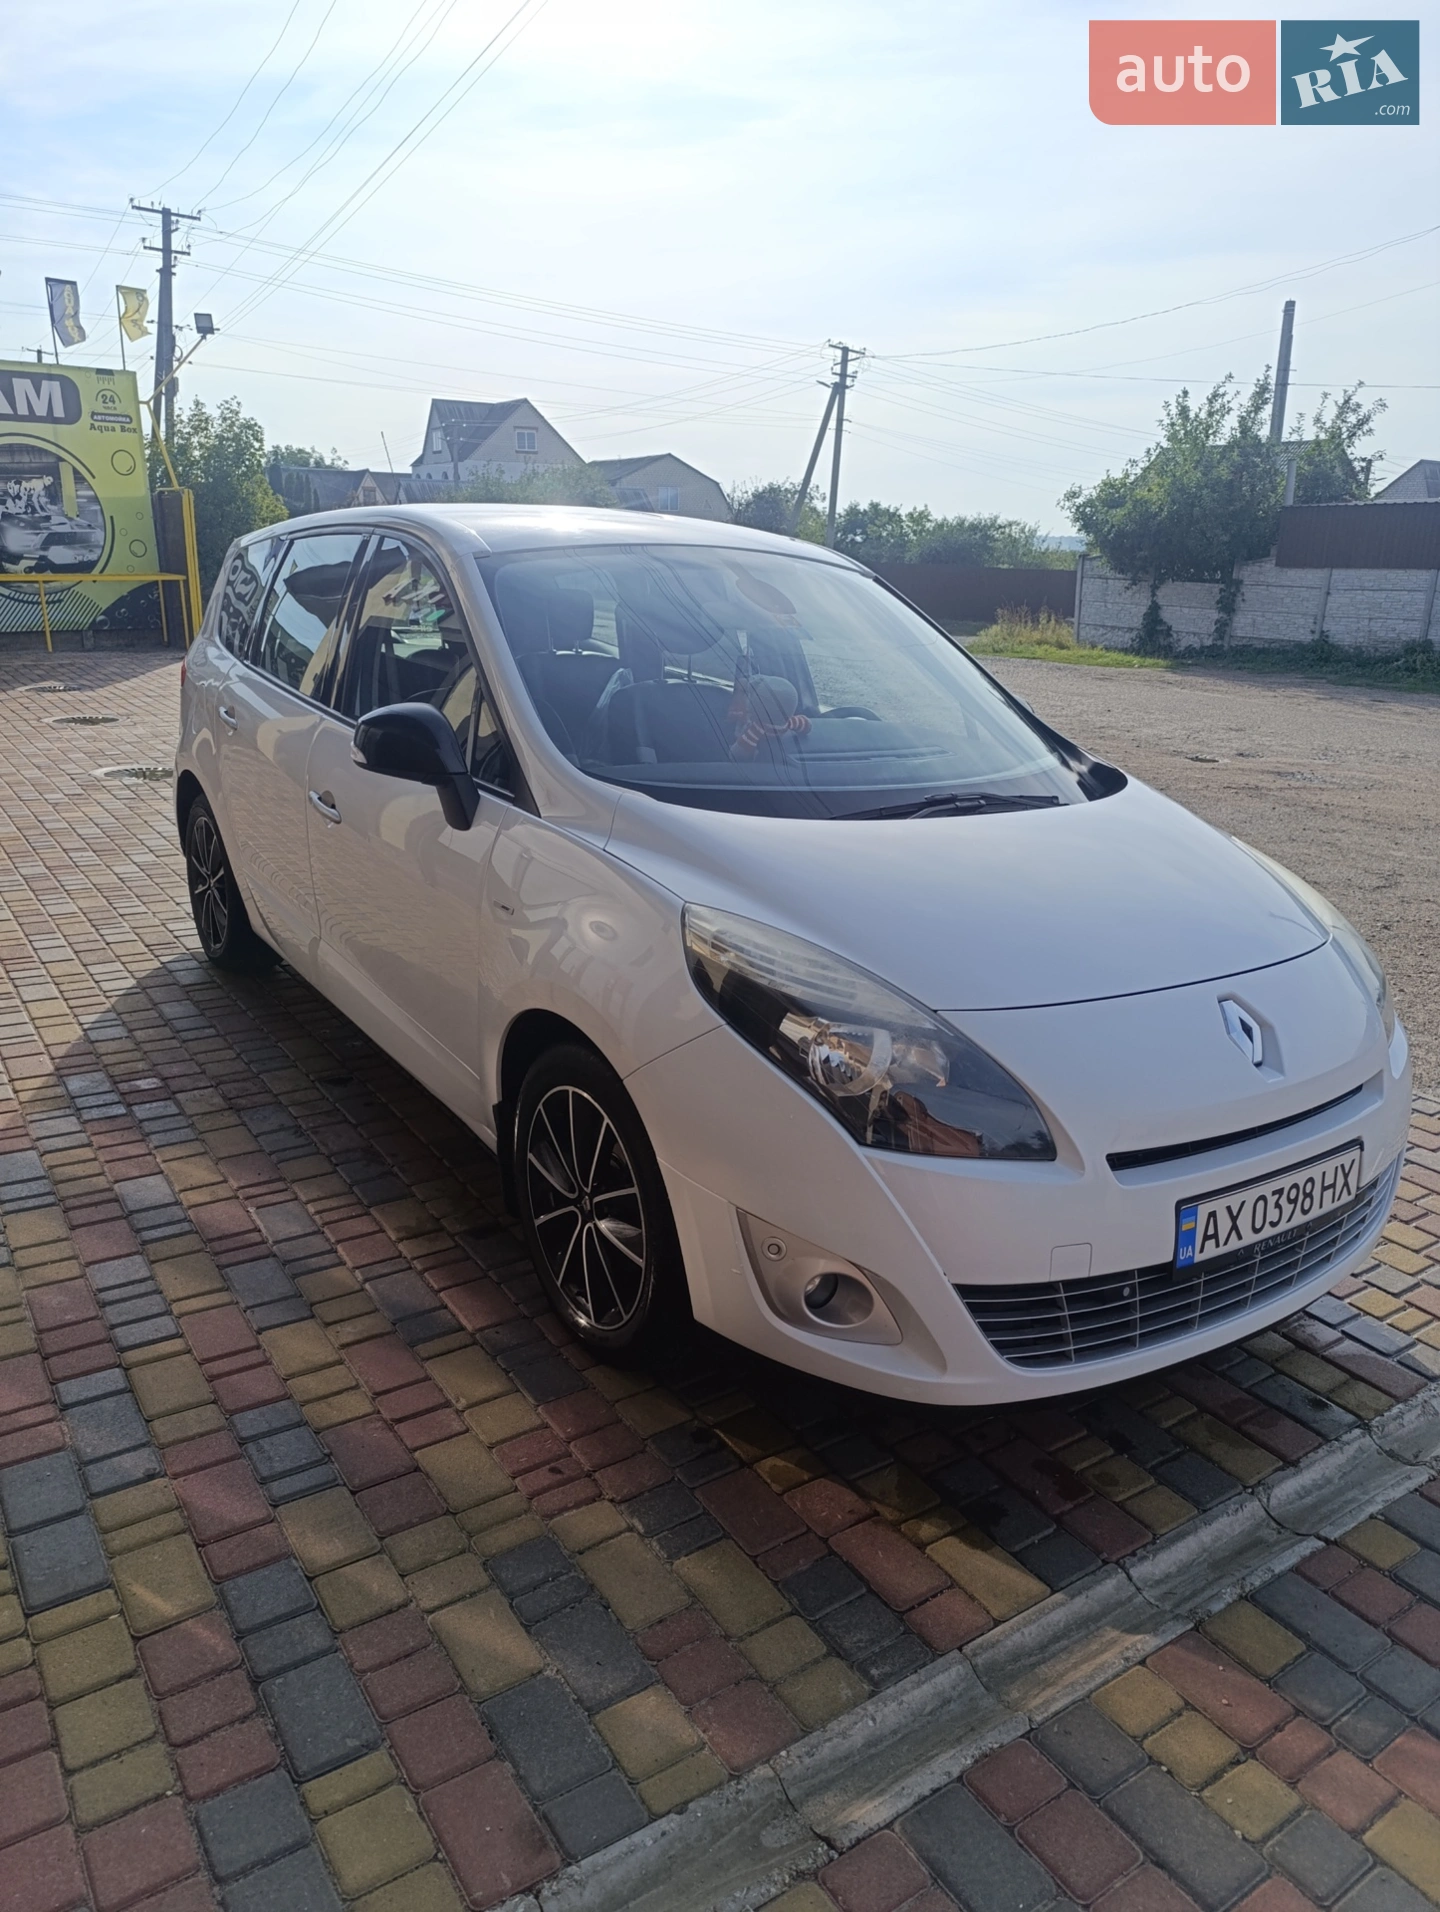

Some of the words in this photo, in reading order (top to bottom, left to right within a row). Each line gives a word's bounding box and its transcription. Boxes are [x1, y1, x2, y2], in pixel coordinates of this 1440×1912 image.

[101, 394, 116, 405] 24
[89, 423, 117, 434] Aqua
[120, 425, 138, 434] Box
[1199, 1200, 1246, 1254] AX
[1251, 1176, 1316, 1234] 0398
[1319, 1158, 1356, 1209] HX
[1253, 1228, 1298, 1254] RENAULT
[1179, 1244, 1194, 1260] UA
